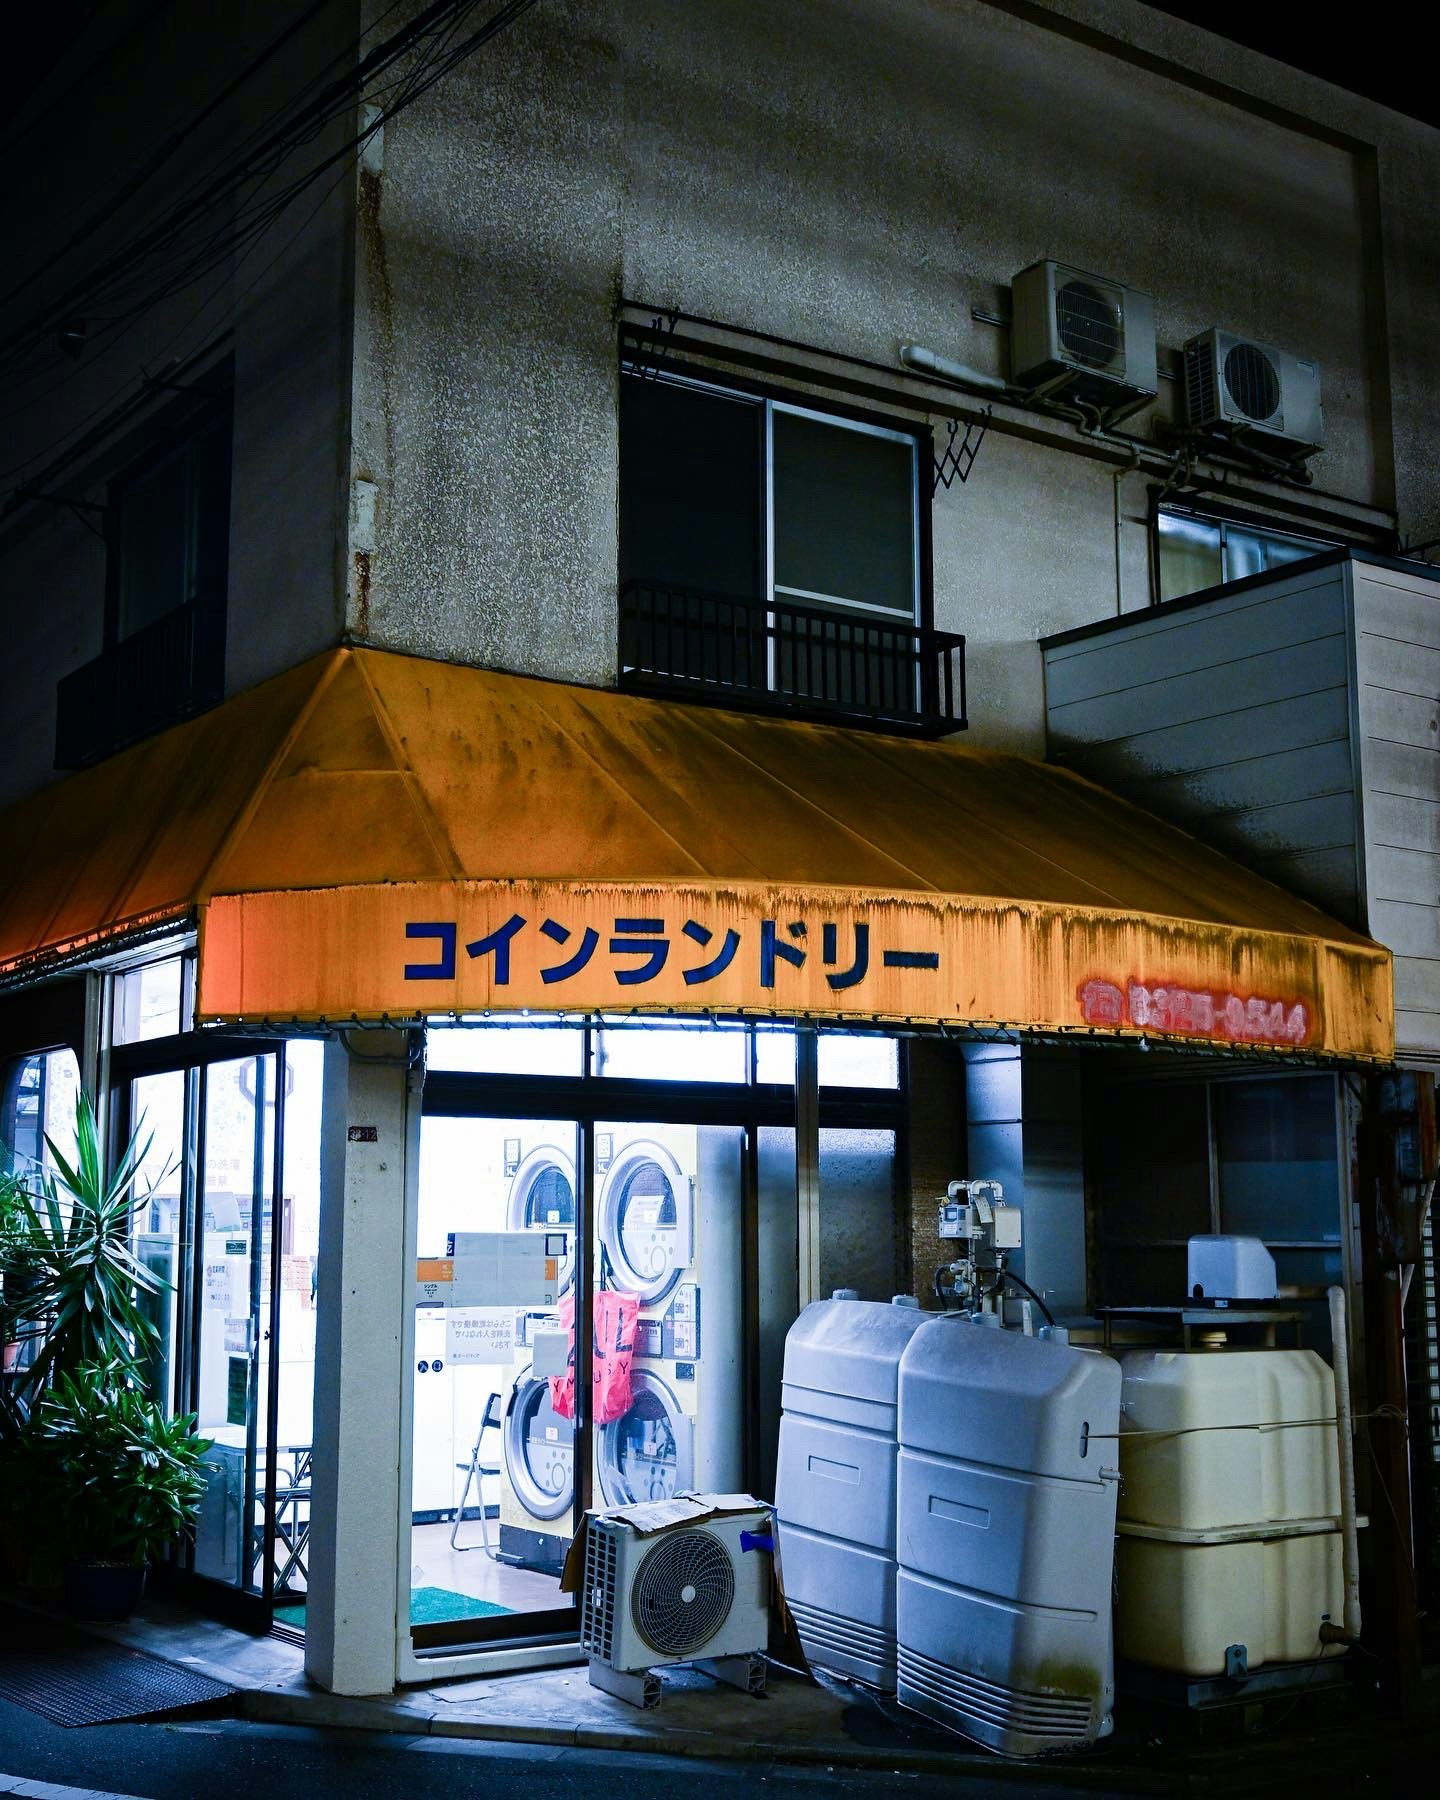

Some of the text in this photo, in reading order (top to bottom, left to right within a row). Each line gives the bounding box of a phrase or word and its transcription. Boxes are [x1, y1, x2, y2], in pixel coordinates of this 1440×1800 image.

[404, 913, 939, 990] コインランドリー
